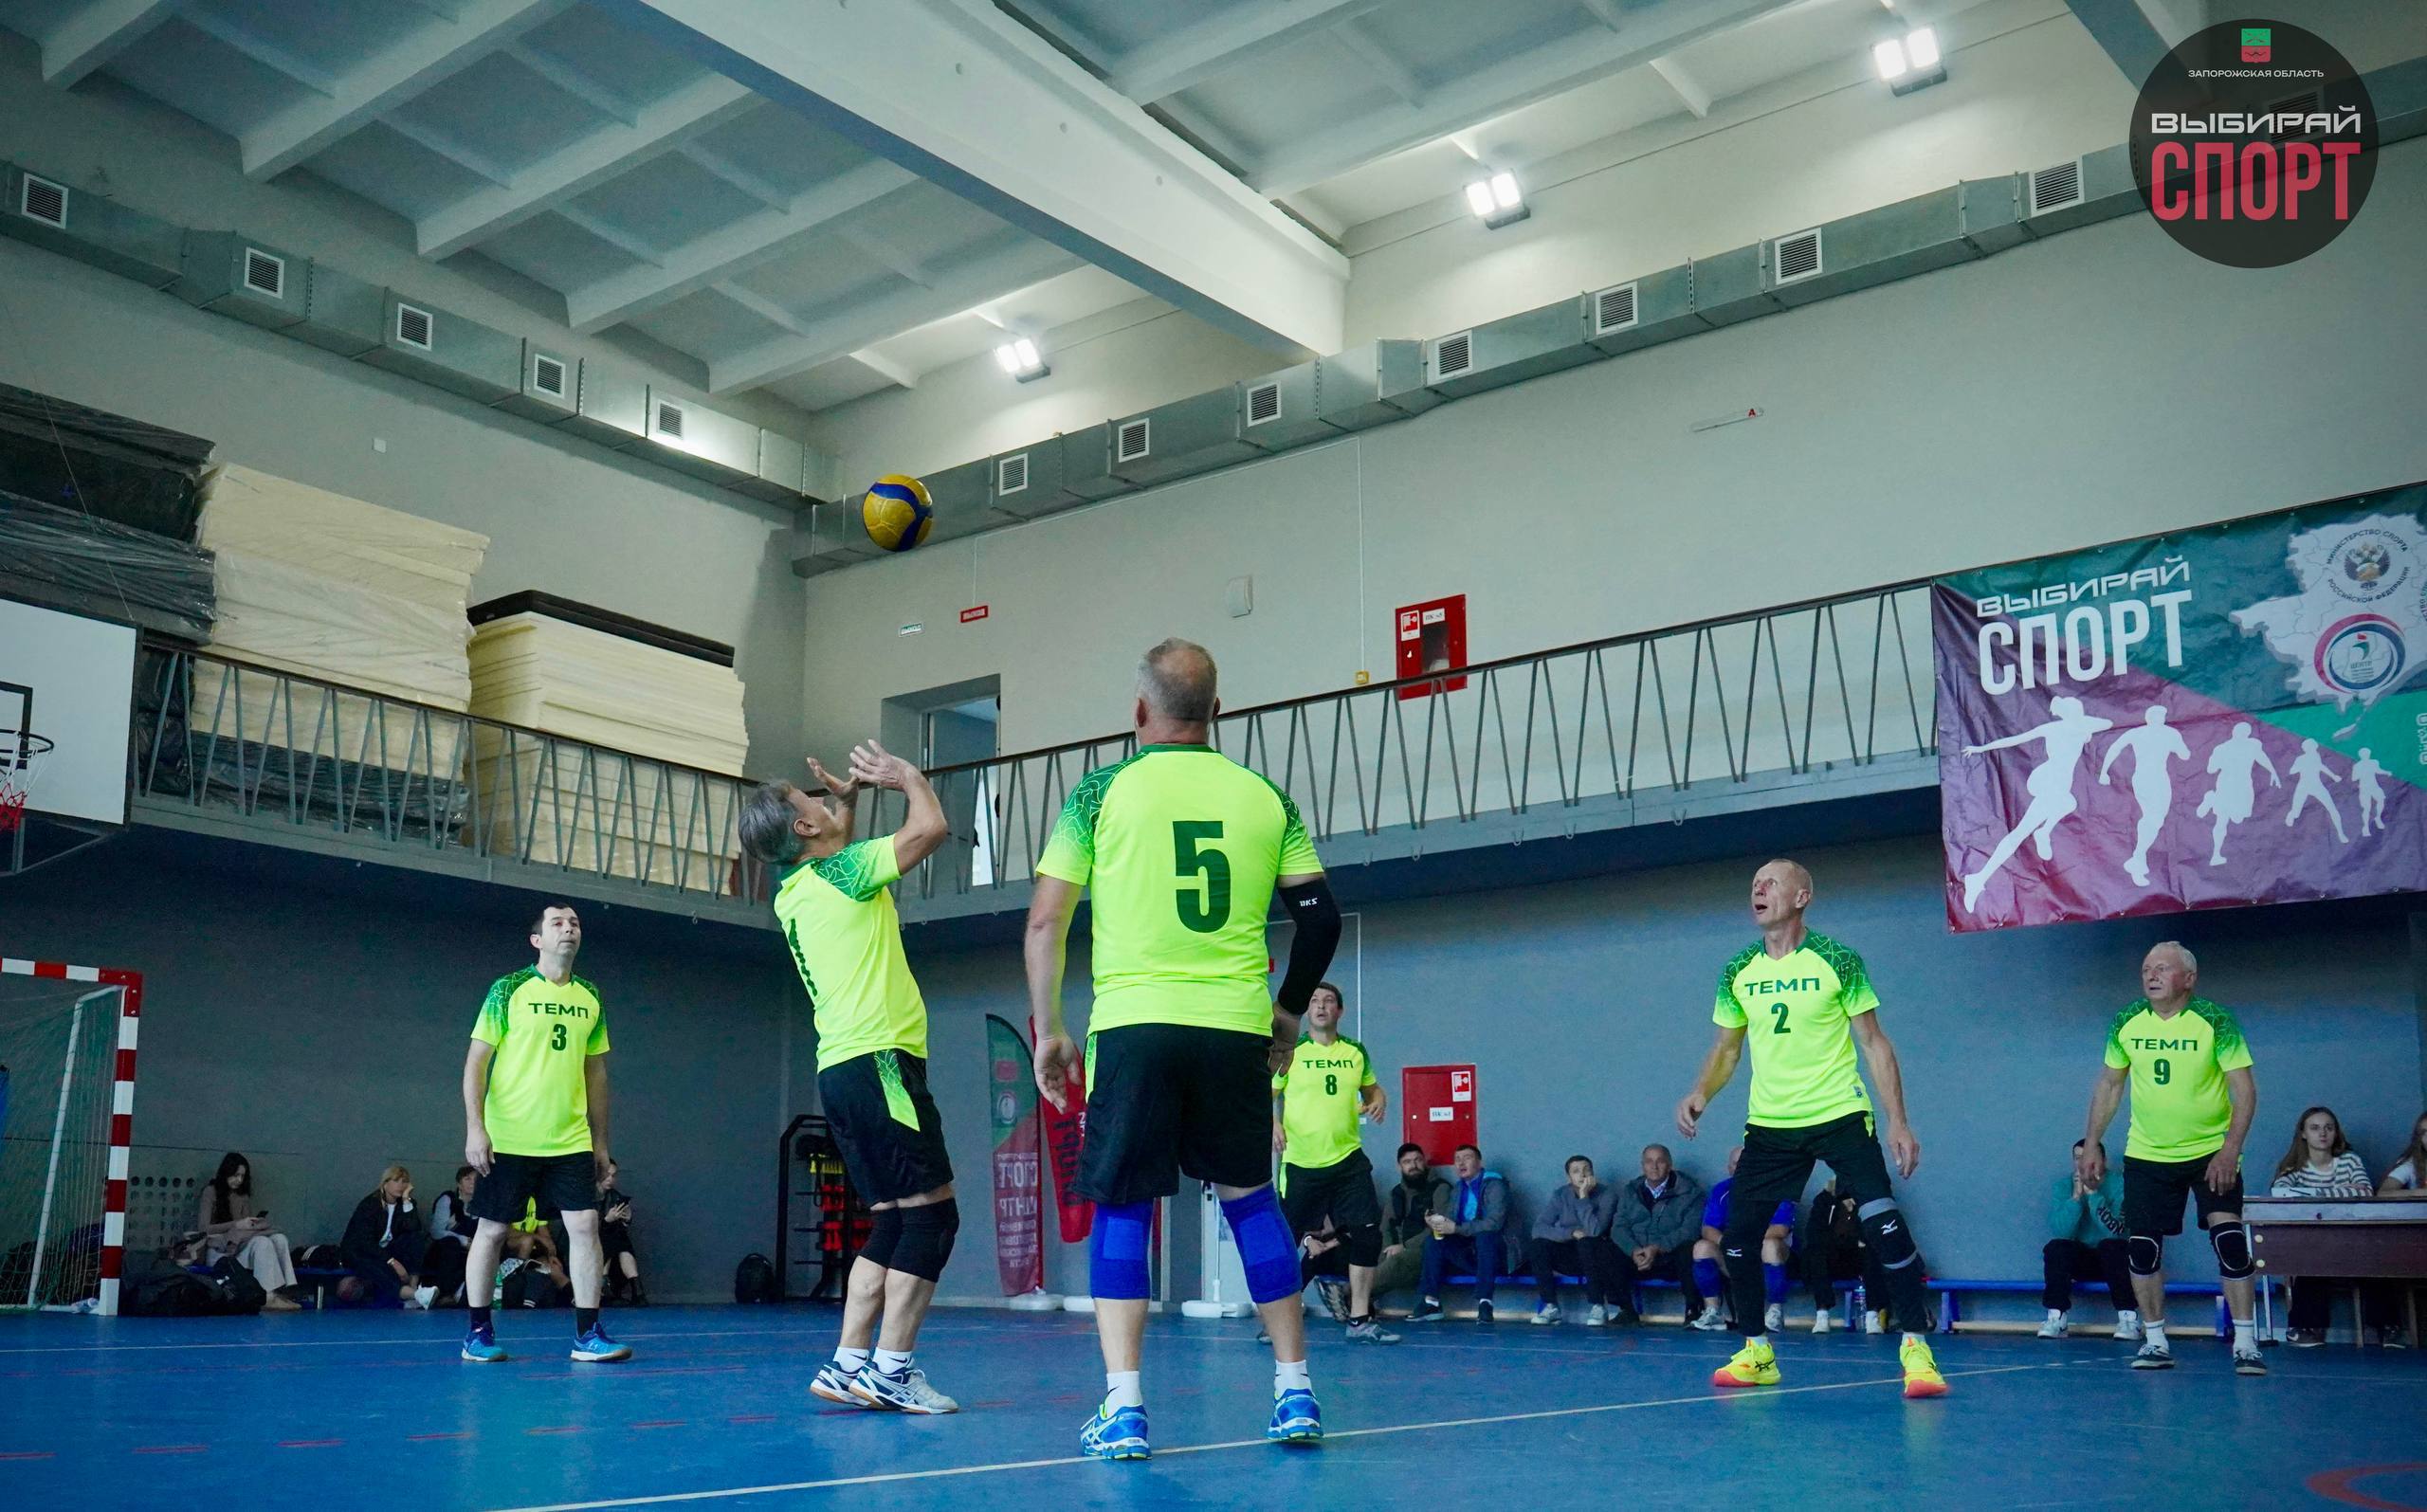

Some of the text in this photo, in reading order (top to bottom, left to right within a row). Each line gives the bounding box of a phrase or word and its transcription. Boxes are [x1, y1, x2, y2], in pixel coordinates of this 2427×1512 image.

[1976, 555, 2191, 618] ВЫБИРАЙ
[1978, 589, 2193, 696] СПОРТ
[1172, 820, 1232, 934] 5
[1744, 977, 1821, 996] ТЕМП
[528, 1002, 589, 1019] ТЕМП
[1771, 1002, 1791, 1035] 2
[552, 1024, 567, 1051] 3
[2131, 1038, 2198, 1051] ТЕМП
[1303, 1060, 1354, 1069] ТЕМП
[2153, 1058, 2171, 1085] 9
[1324, 1074, 1338, 1096] 8
